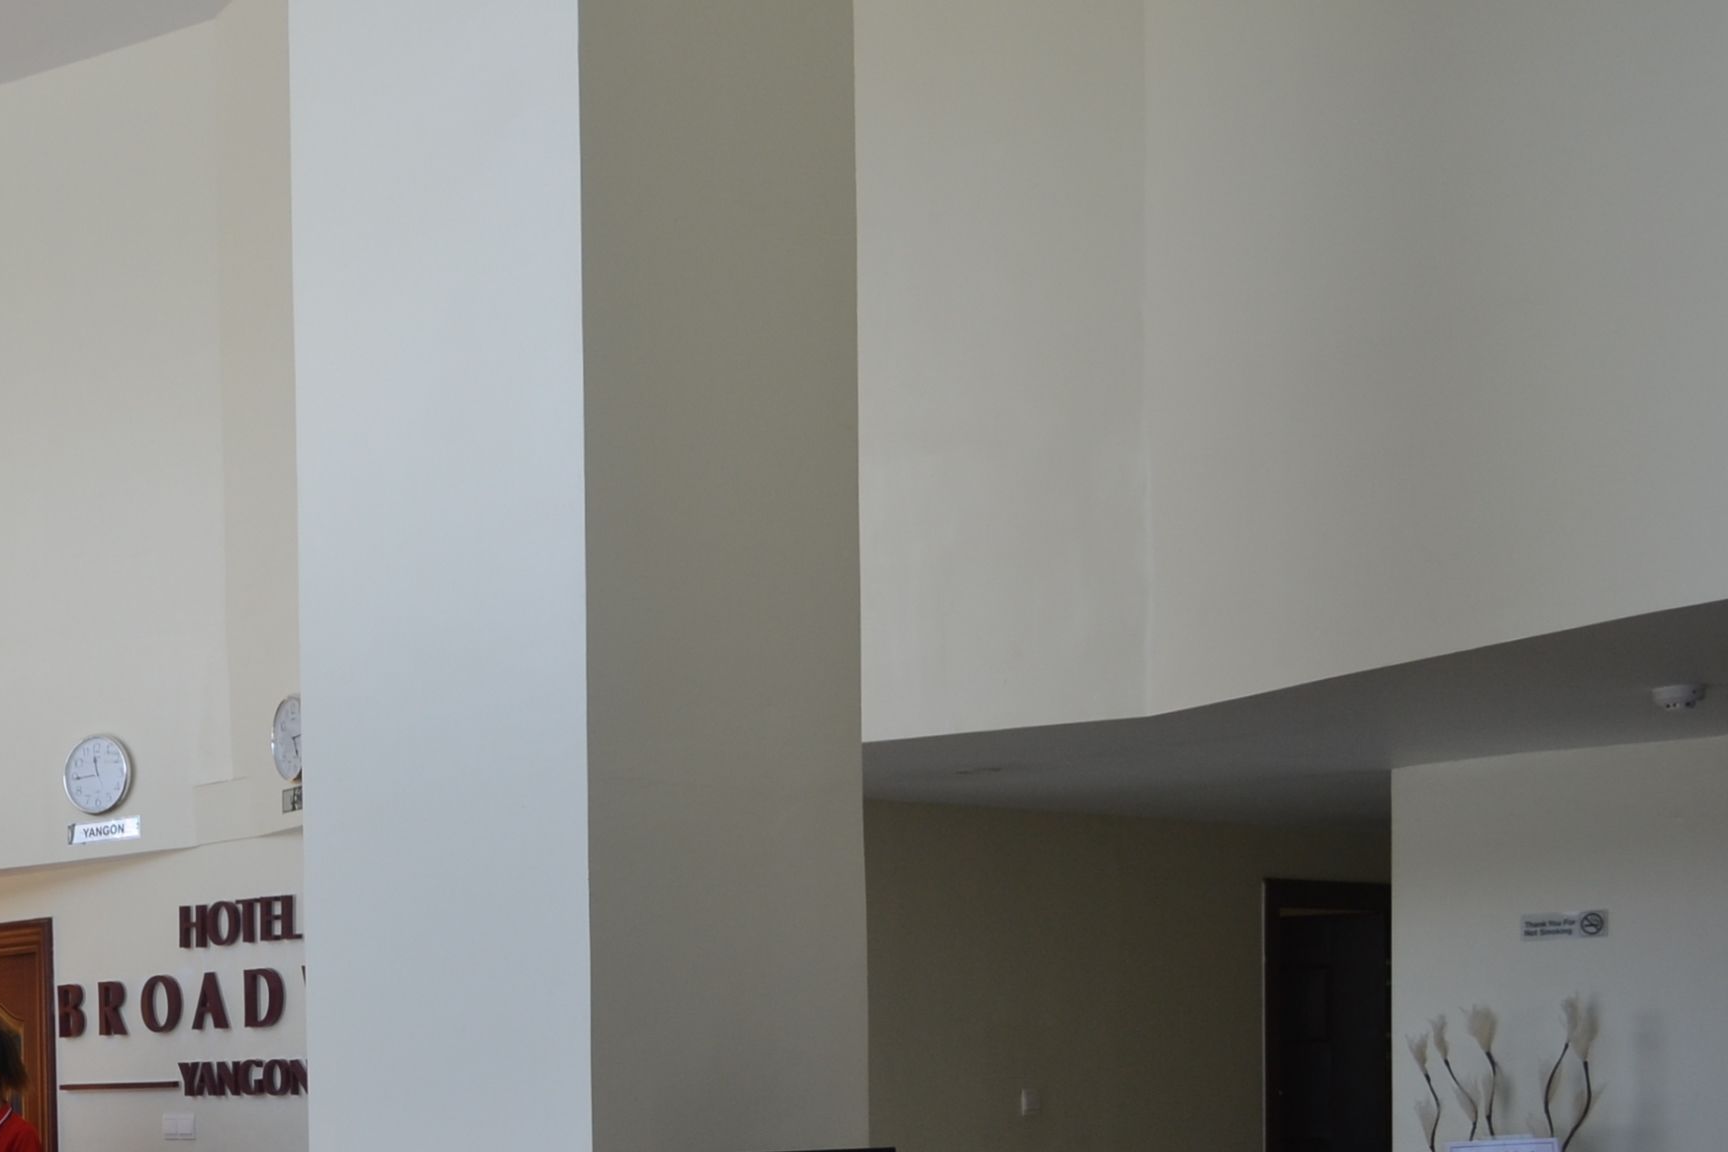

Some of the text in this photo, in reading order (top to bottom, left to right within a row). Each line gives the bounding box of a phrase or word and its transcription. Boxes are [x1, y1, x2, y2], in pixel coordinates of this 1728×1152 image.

[83, 824, 125, 838] YANGON
[178, 894, 303, 948] HOTEL
[1539, 928, 1572, 936] Smoking
[57, 965, 306, 1038] BROAD
[178, 1058, 308, 1097] YANGON
